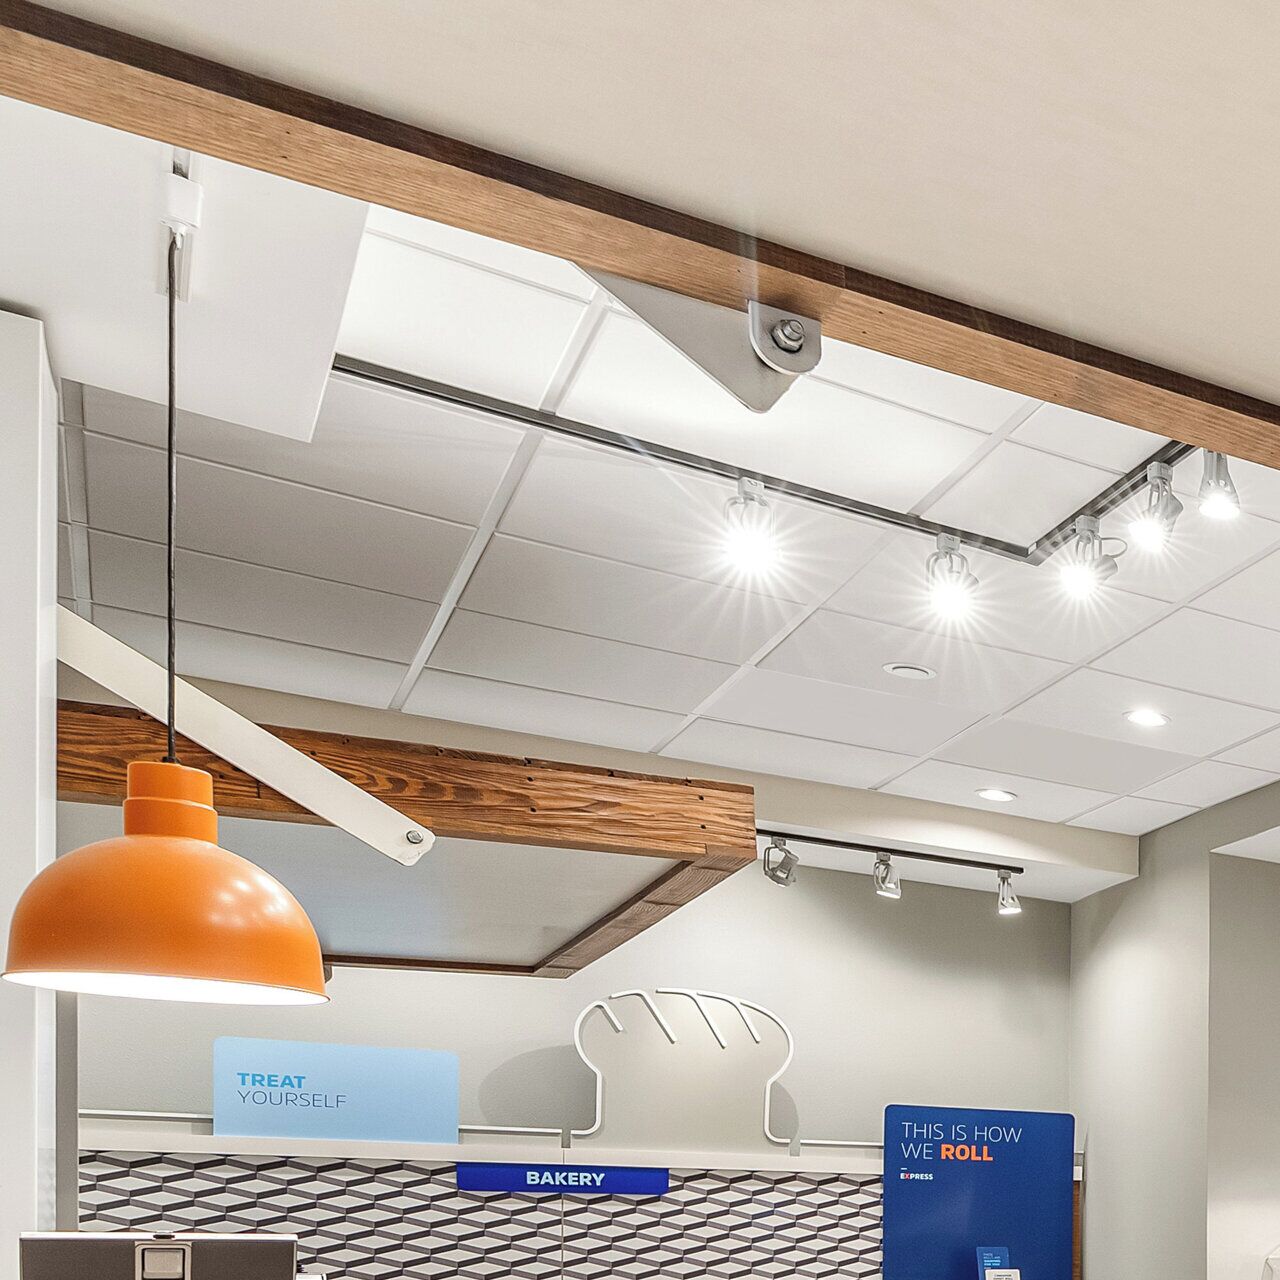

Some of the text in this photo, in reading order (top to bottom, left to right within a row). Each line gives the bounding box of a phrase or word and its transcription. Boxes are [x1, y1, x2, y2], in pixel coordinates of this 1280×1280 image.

[237, 1072, 306, 1089] TREAT
[237, 1090, 347, 1109] YOURSELF
[901, 1121, 1022, 1143] THIS IS HOW
[901, 1142, 994, 1161] WE ROLL
[526, 1171, 605, 1186] BAKERY
